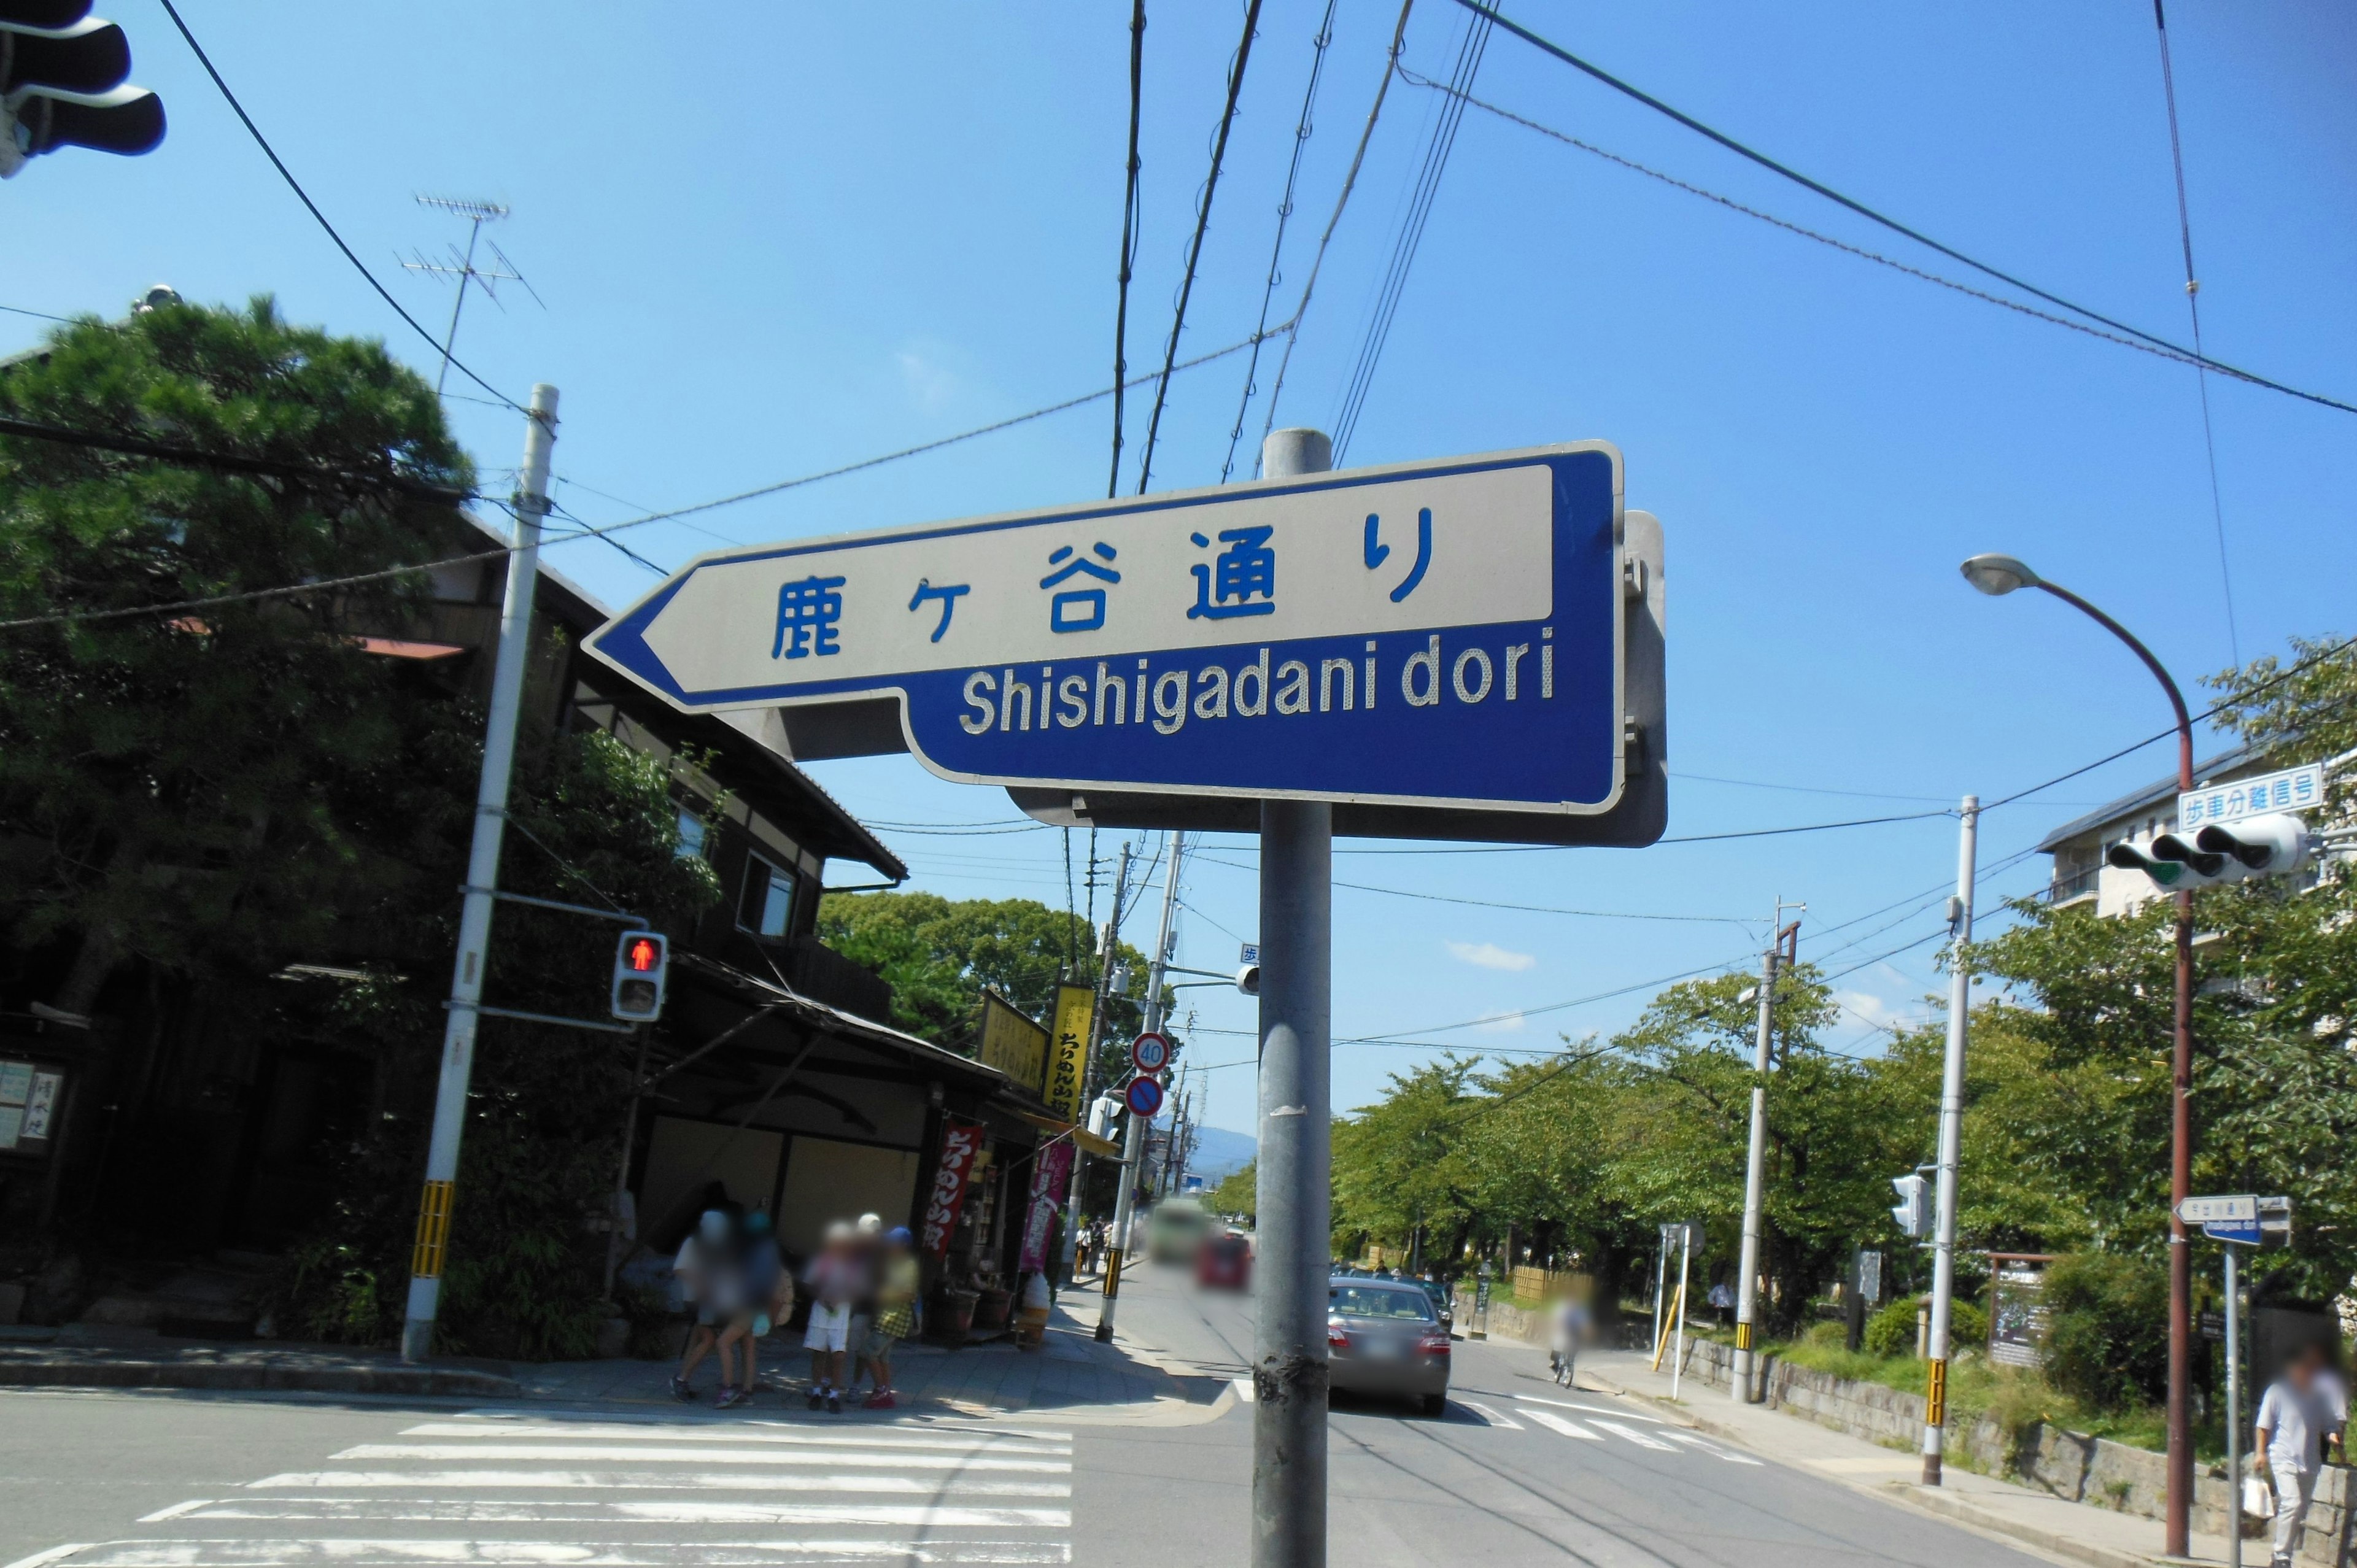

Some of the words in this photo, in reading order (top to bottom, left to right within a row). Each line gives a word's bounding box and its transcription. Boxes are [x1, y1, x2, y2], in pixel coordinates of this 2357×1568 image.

[959, 641, 1376, 735] Shishigadani
[1401, 627, 1553, 707] dori
[2186, 773, 2313, 824] 歩車分離信号
[1244, 948, 1260, 960] 歩
[1140, 1044, 1161, 1063] 40
